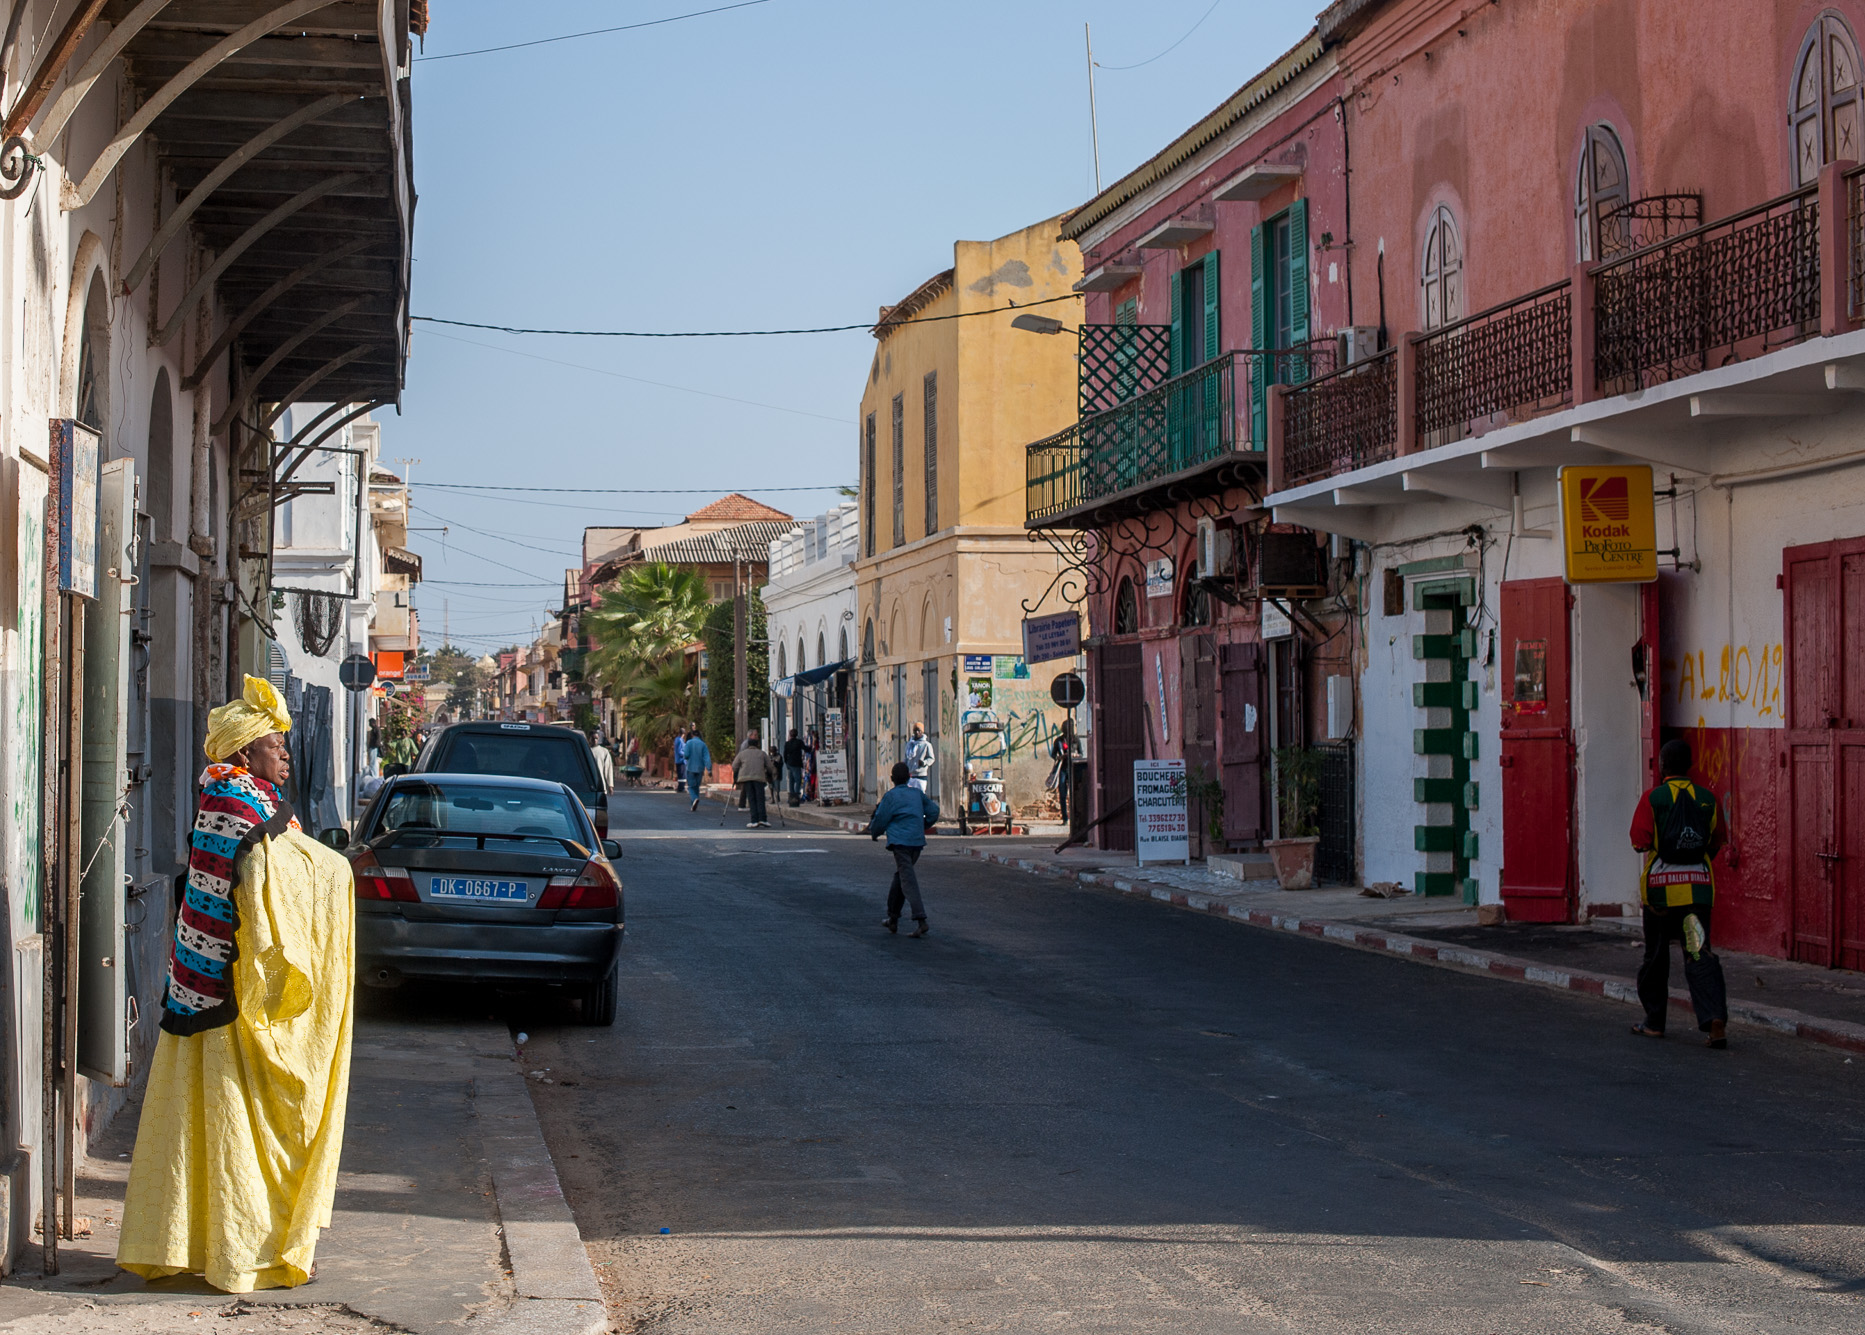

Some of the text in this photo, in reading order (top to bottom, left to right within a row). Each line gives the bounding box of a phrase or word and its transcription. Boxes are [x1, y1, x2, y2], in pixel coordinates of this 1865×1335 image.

[1582, 524, 1630, 538] Kodak
[1028, 617, 1076, 634] Librairie Papeterie
[1136, 772, 1185, 781] BOUCHERIE
